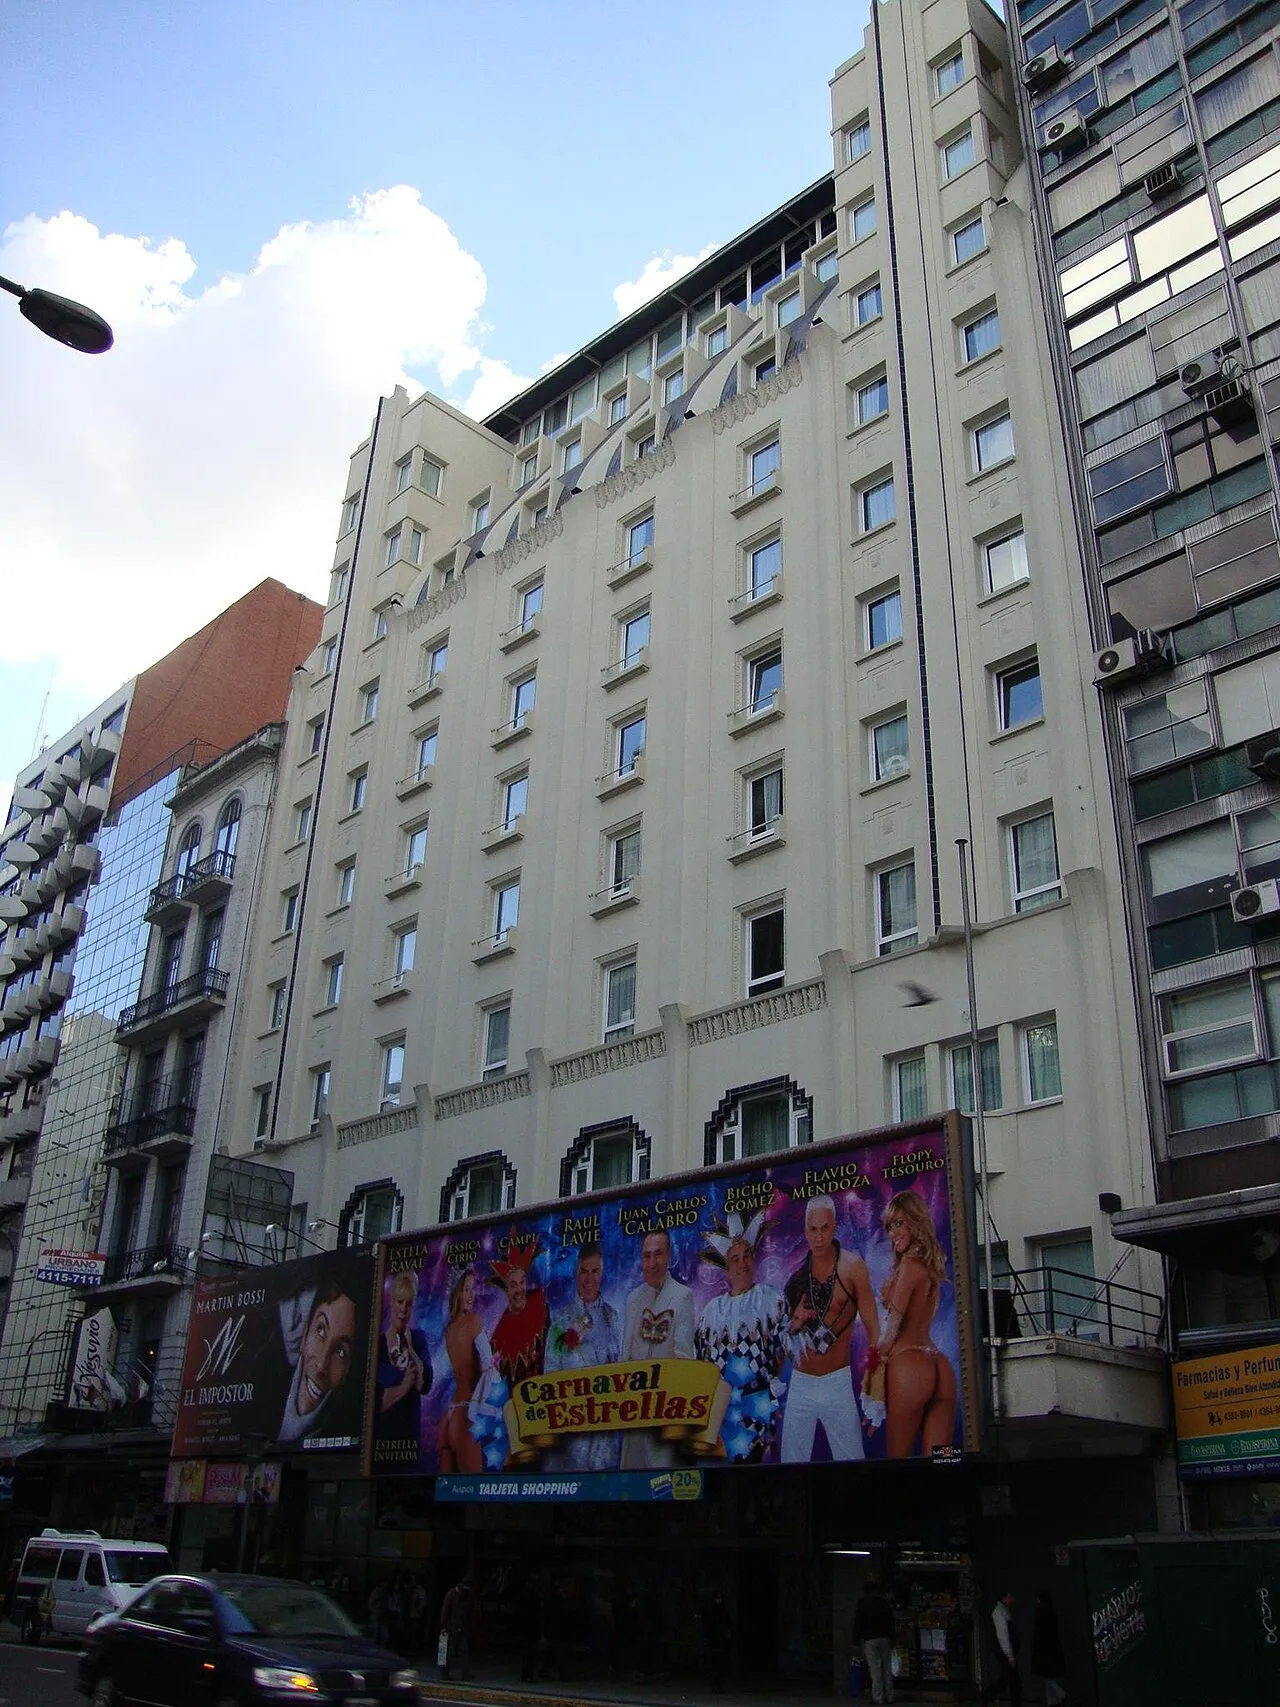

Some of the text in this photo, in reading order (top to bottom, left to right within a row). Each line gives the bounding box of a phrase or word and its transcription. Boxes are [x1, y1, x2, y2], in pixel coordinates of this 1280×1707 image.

[893, 1149, 932, 1166] FLOPY
[804, 1163, 857, 1184] FLAVIO
[882, 1159, 944, 1178] TESOURO
[727, 1181, 773, 1200] BICHO
[792, 1175, 871, 1200] MENDOZA
[618, 1195, 707, 1224] JUAN CARLOS
[724, 1194, 775, 1213] GOMEZ
[564, 1215, 600, 1232] RAUL
[625, 1211, 698, 1235] CALABRO
[446, 1240, 481, 1254] JESSICA
[563, 1229, 600, 1247] LAVIE
[60, 1250, 89, 1258] Alquila
[390, 1244, 428, 1260] ESTELA
[447, 1252, 477, 1264] CIRIO
[50, 1258, 97, 1268] URBANO
[391, 1258, 424, 1273] RAVAL
[38, 1271, 101, 1285] 4115-7111
[196, 1289, 266, 1313] MARTIN BOSSI
[520, 1363, 661, 1404] Carnaval
[1177, 1366, 1231, 1387] Farmacias
[1235, 1365, 1240, 1381] y
[184, 1383, 254, 1406] EL IMPOSTOR
[526, 1391, 709, 1430] de Estrellas
[376, 1440, 418, 1450] ESTRELLA
[374, 1451, 417, 1461] INVITADA
[479, 1483, 518, 1495] TARJETA
[521, 1482, 580, 1495] SHOPPING
